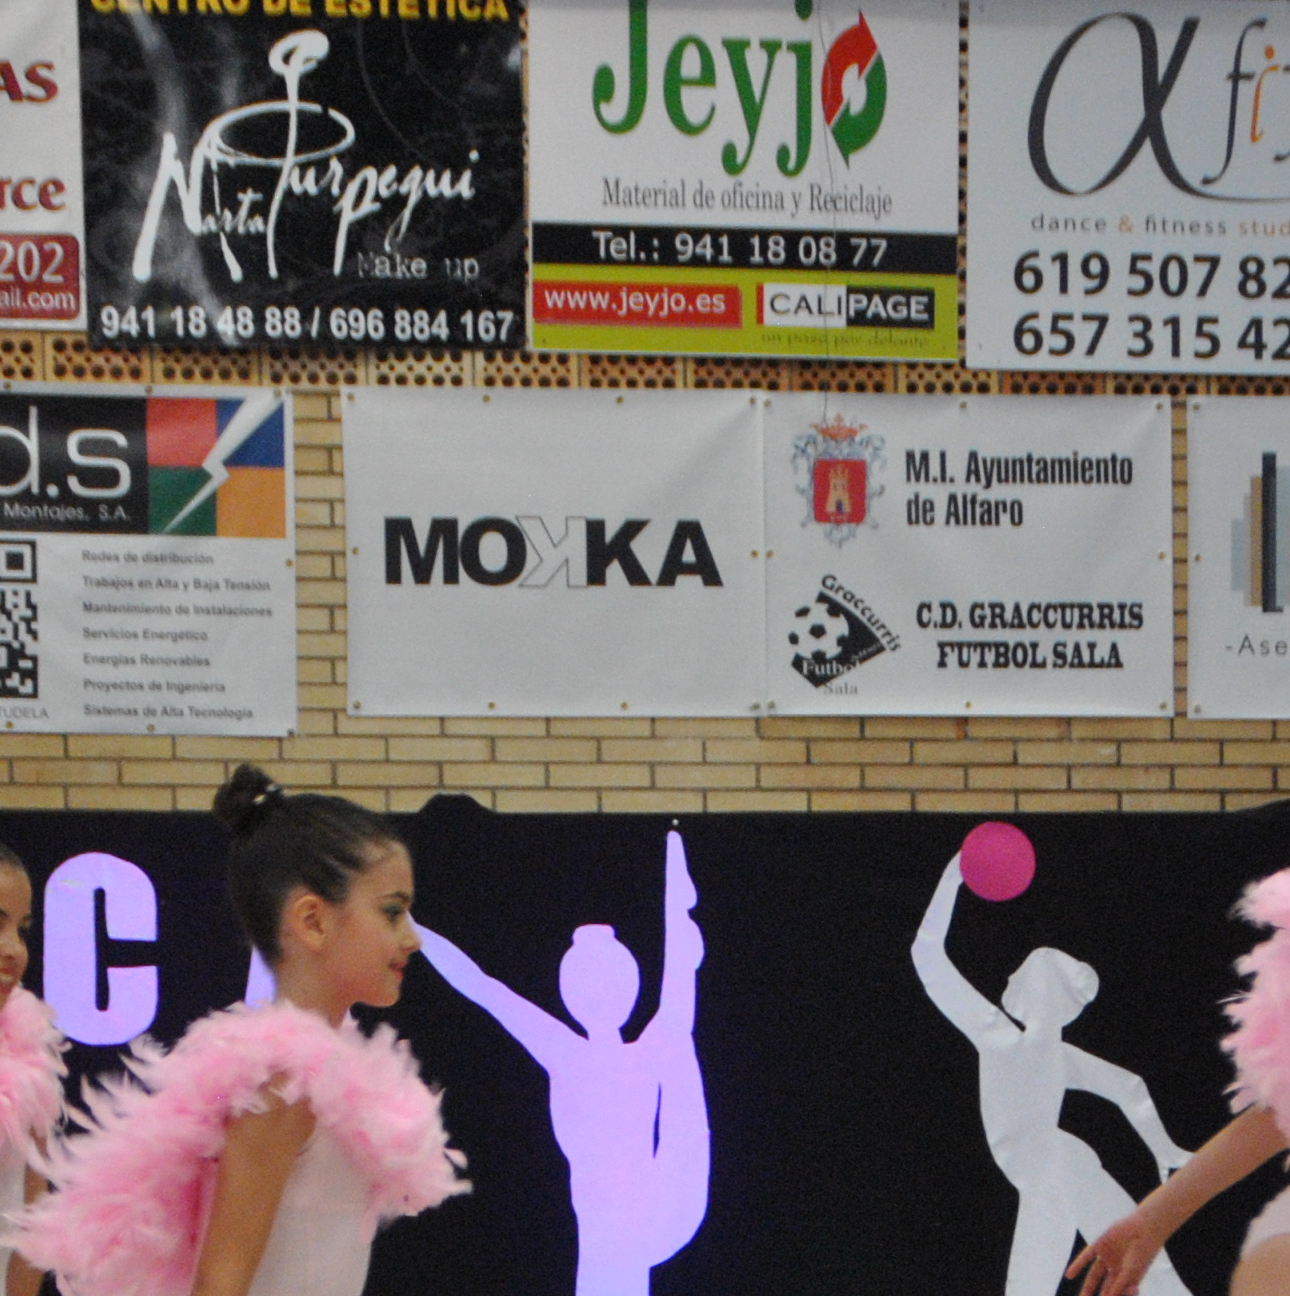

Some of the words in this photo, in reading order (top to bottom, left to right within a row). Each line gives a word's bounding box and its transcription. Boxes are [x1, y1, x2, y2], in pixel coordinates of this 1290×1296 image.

[602, 177, 686, 209] Material
[693, 180, 715, 210] de
[721, 182, 784, 211] oficina
[790, 192, 803, 218] y
[809, 183, 893, 219] Reciclaje
[1031, 213, 1107, 232] dance
[1118, 215, 1134, 232] &
[1144, 214, 1227, 234] fitness
[592, 230, 659, 261] Tel.:
[675, 233, 733, 262] 941
[749, 235, 785, 264] 18
[798, 236, 837, 265] 08
[850, 238, 888, 267] 77
[1014, 249, 1110, 295] 619
[1127, 252, 1221, 298] 507
[545, 286, 726, 318] www.jeyjo.es
[100, 305, 156, 338] 941
[170, 305, 207, 338] 18
[217, 306, 254, 339] 48
[265, 306, 302, 340] 88
[329, 308, 385, 340] 696
[394, 309, 449, 341] 884
[460, 309, 513, 342] 167
[1013, 312, 1109, 357] 657
[1127, 314, 1220, 359] 315
[905, 450, 954, 484] M.I.
[965, 451, 1133, 489] Ayuntamiento
[907, 494, 935, 526] de
[945, 493, 1024, 526] Alfaro
[124, 551, 138, 563] de
[384, 516, 723, 588] MOKKA
[83, 576, 134, 591] Trabajos
[137, 578, 152, 589] en
[156, 577, 179, 590] Alta
[193, 578, 219, 592] Baja
[916, 602, 963, 630] C.D.
[969, 602, 1143, 631] GRACCURRIS
[83, 627, 139, 639] Servicios
[140, 653, 211, 667] Renovables
[937, 641, 1046, 669] FUTBOL
[1052, 641, 1124, 669] SALA
[83, 679, 144, 693] Proyectos
[161, 706, 184, 717] Alta
